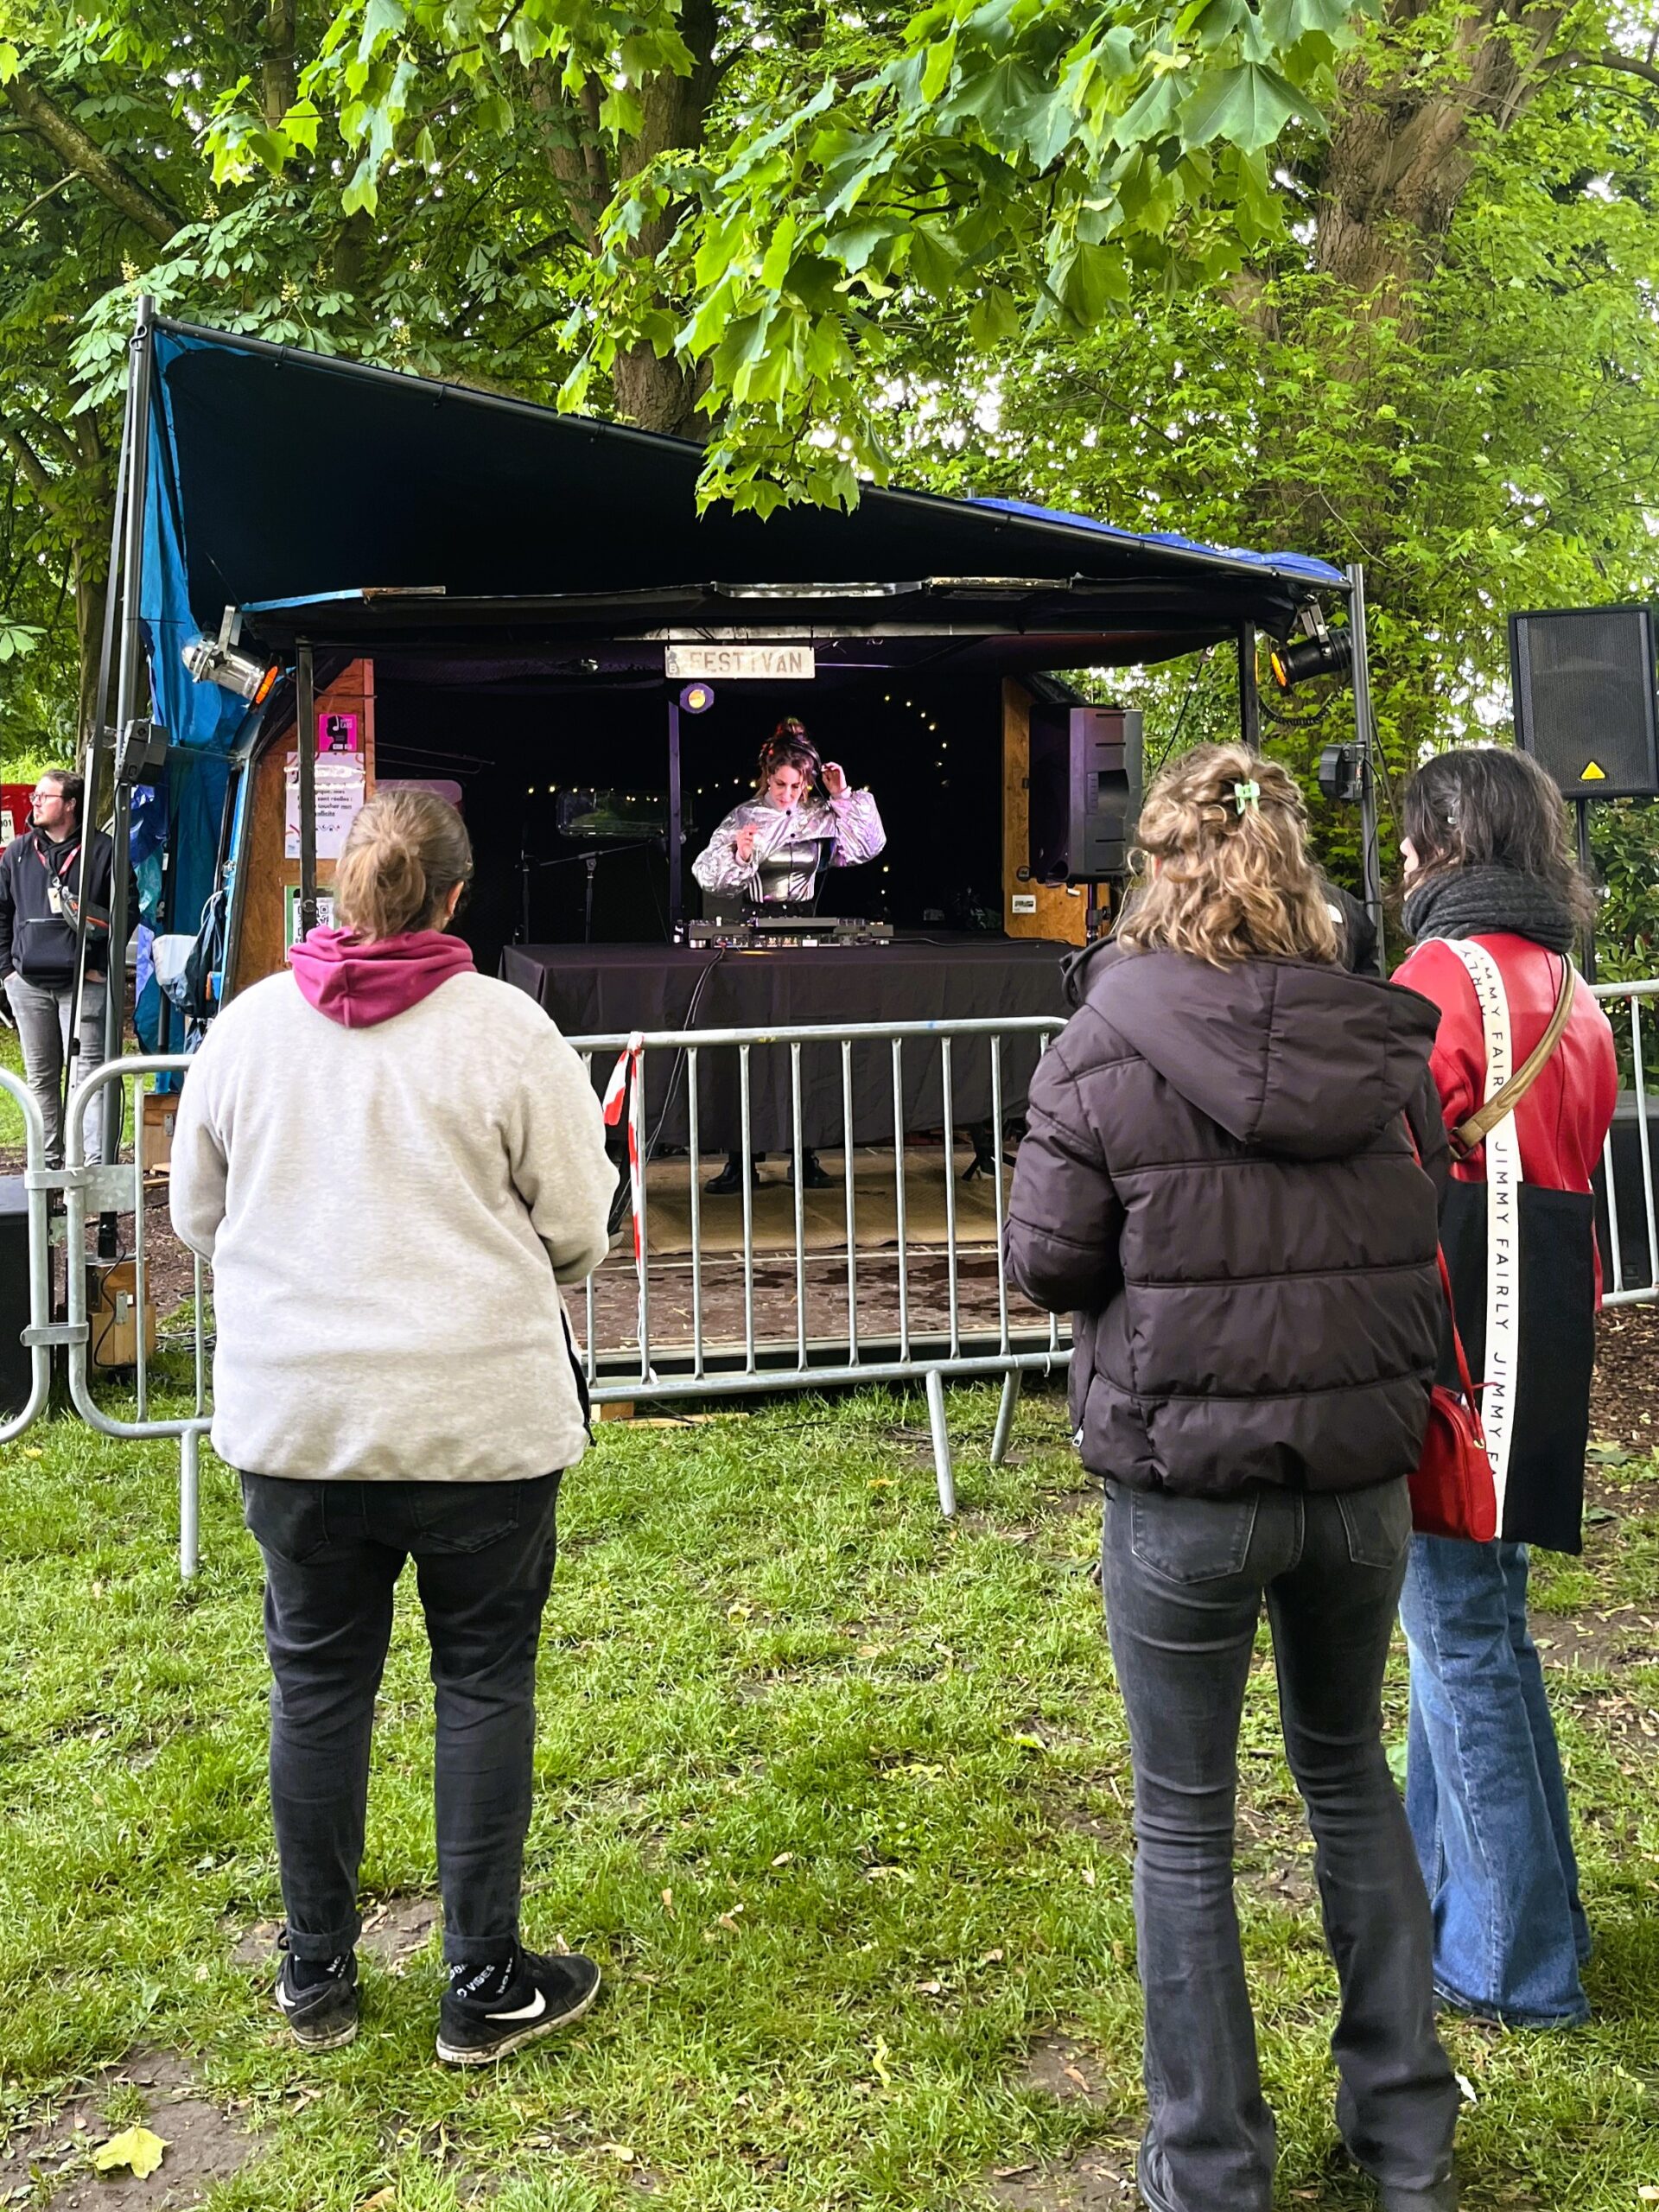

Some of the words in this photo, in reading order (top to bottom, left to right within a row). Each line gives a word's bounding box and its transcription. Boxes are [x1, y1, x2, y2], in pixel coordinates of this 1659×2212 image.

[1495, 1142, 1509, 1224] JIMMY
[1496, 1238, 1510, 1329] FAIRLY
[1489, 1351, 1507, 1438] JIMMY
